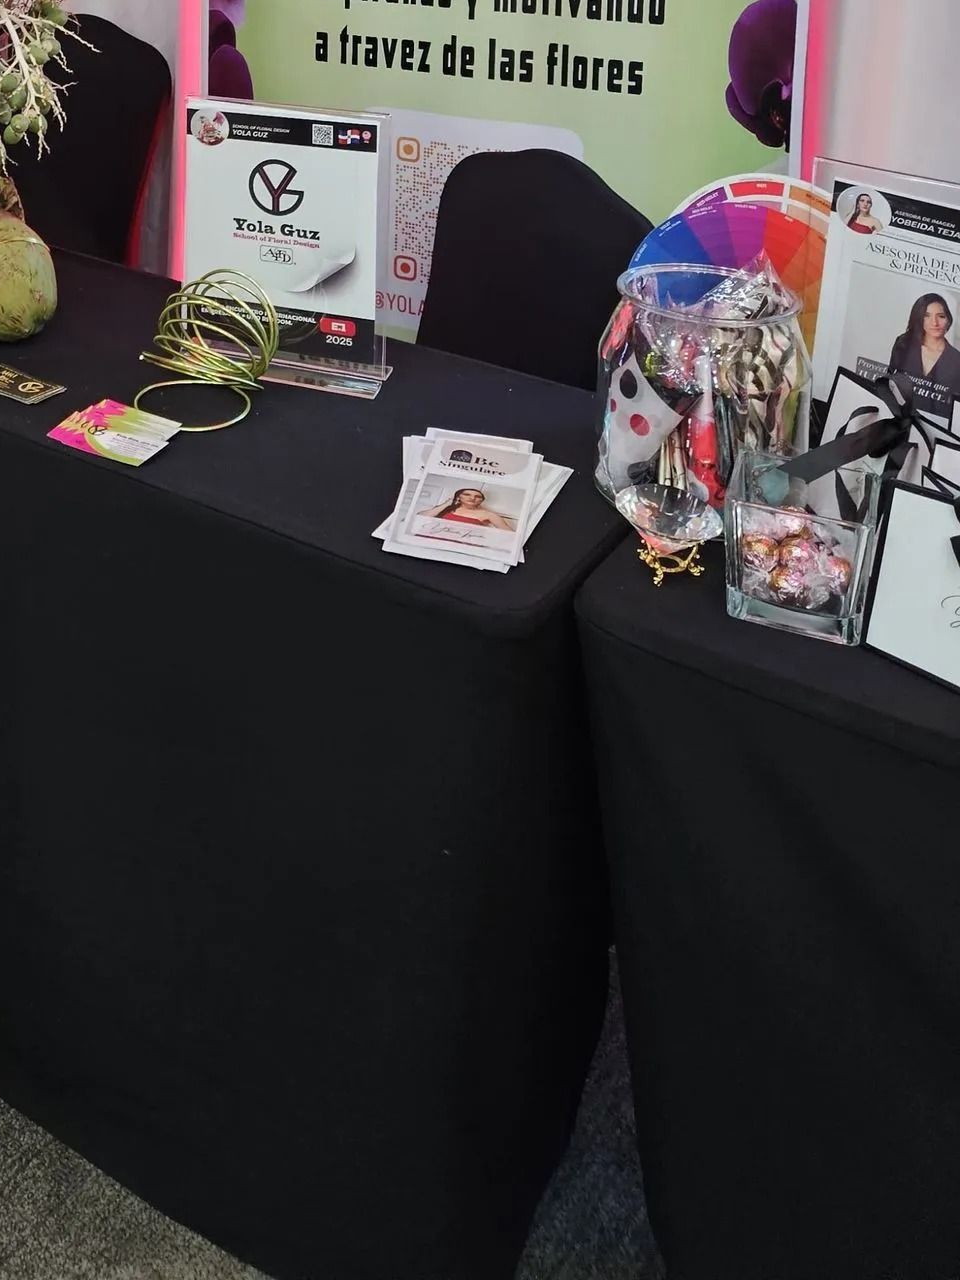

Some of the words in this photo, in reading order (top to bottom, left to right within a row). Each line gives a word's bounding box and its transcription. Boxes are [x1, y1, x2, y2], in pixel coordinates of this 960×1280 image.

[315, 31, 329, 63] a
[340, 24, 432, 74] travez
[442, 34, 475, 79] de
[487, 38, 534, 83] las
[546, 42, 644, 96] flores
[233, 217, 276, 235] Yola
[280, 223, 320, 241] Guz
[891, 215, 935, 233] YOBEIDA
[325, 334, 353, 347] 2025
[438, 459, 507, 477] Singulare
[474, 457, 500, 468] Be
